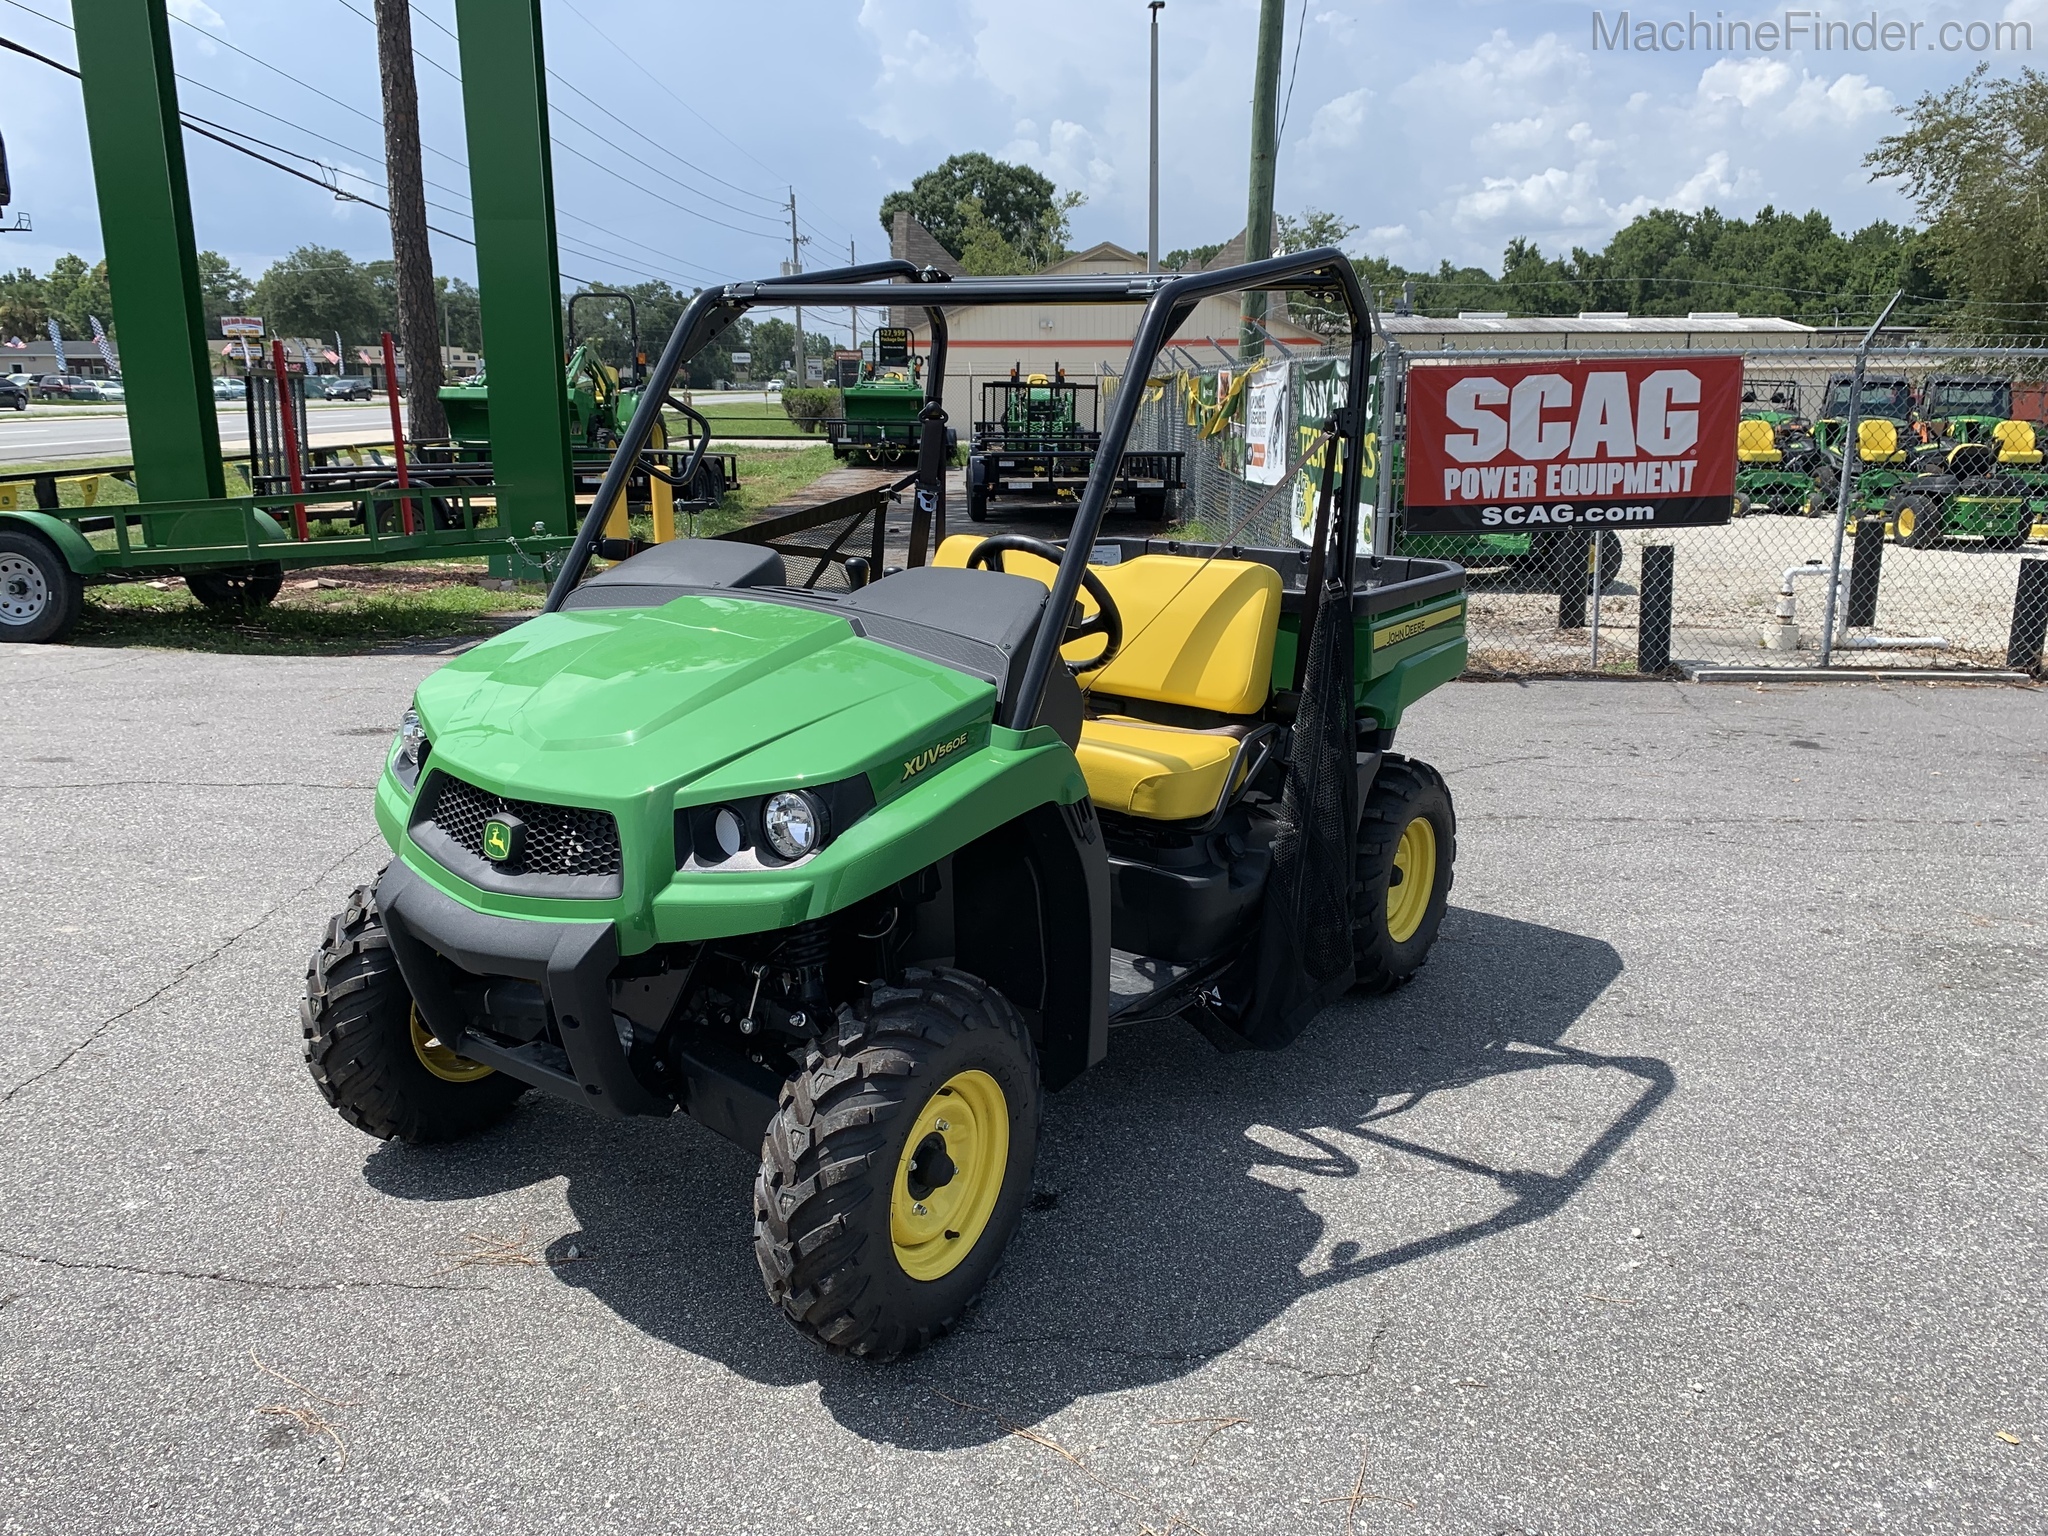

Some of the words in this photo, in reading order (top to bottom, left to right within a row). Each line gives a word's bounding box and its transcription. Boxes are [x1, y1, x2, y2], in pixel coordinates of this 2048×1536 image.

[1445, 369, 1701, 463] SCAG
[1444, 465, 1538, 501] POWER
[1546, 460, 1698, 497] EQUIPMENT
[1482, 504, 1654, 525] SCAG.com
[1386, 629, 1405, 646] JOHN
[1405, 620, 1426, 638] DEERE
[902, 731, 968, 781] XUV560E
